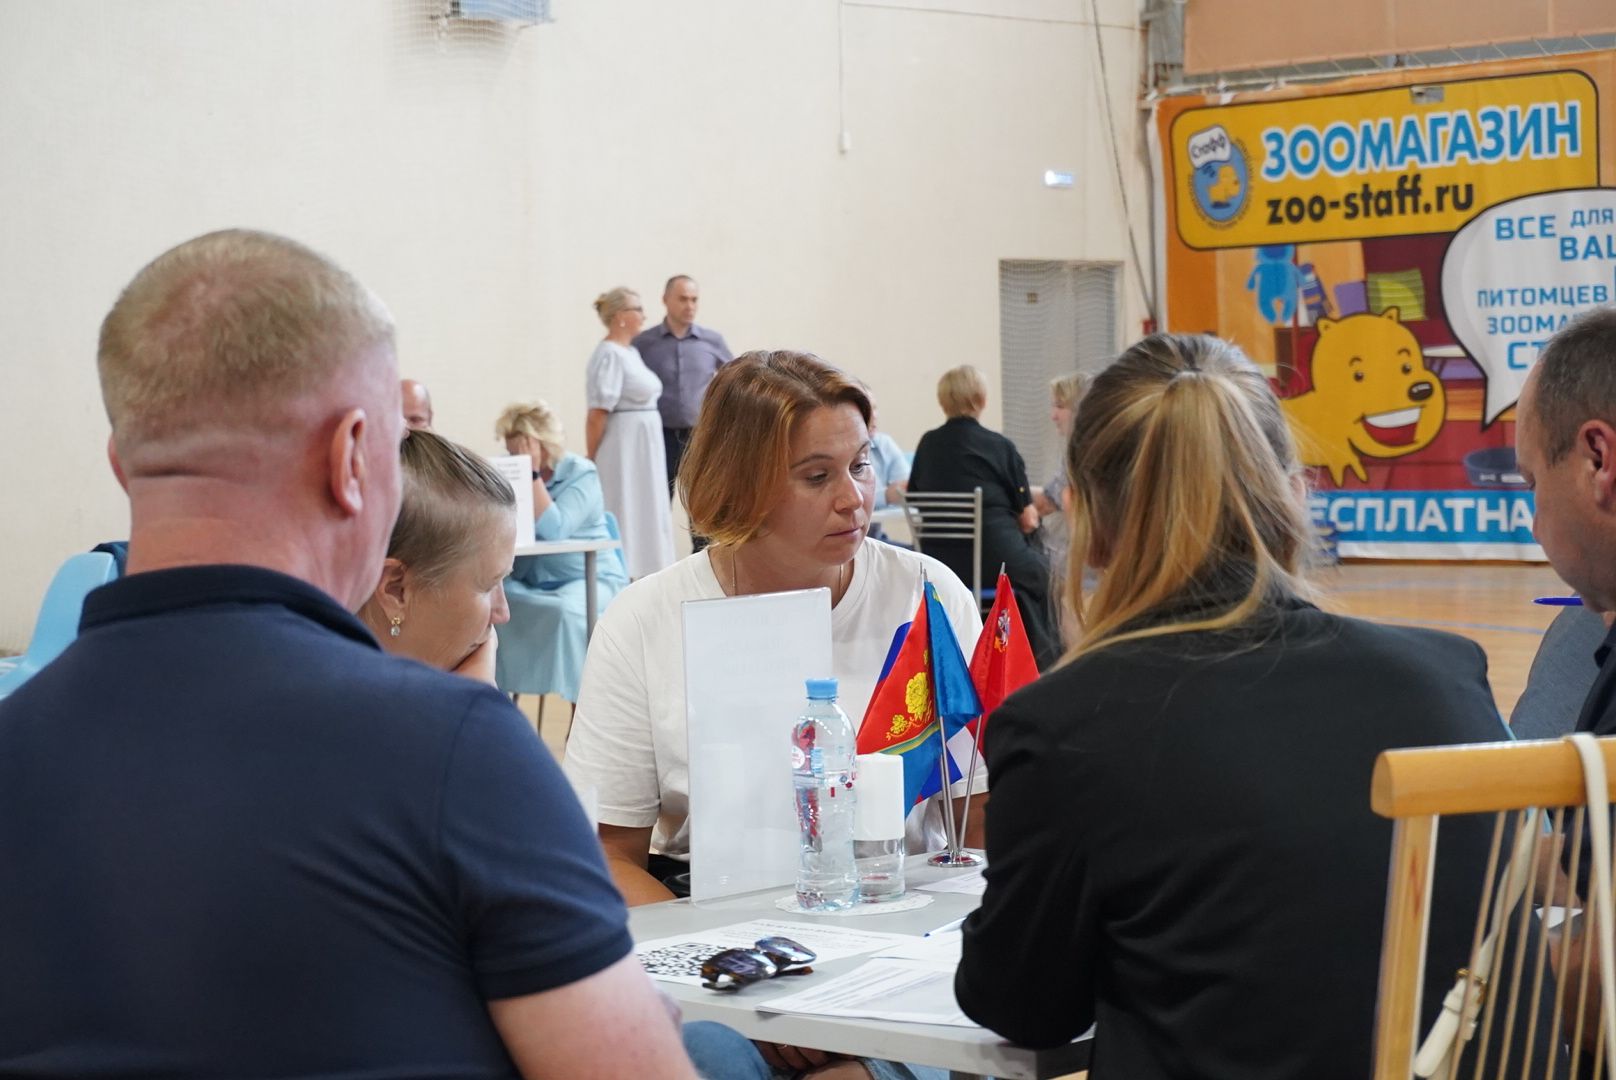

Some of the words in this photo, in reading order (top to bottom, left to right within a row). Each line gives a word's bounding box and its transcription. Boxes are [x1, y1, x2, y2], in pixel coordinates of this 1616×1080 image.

[1262, 102, 1580, 180] ЗООМАГАЗИН
[1266, 174, 1475, 225] zoo-staff.ru
[1495, 215, 1556, 240] ВСЕ
[1570, 208, 1614, 229] ДЛЯ
[1477, 285, 1608, 308] ПИТОМЦЕВ
